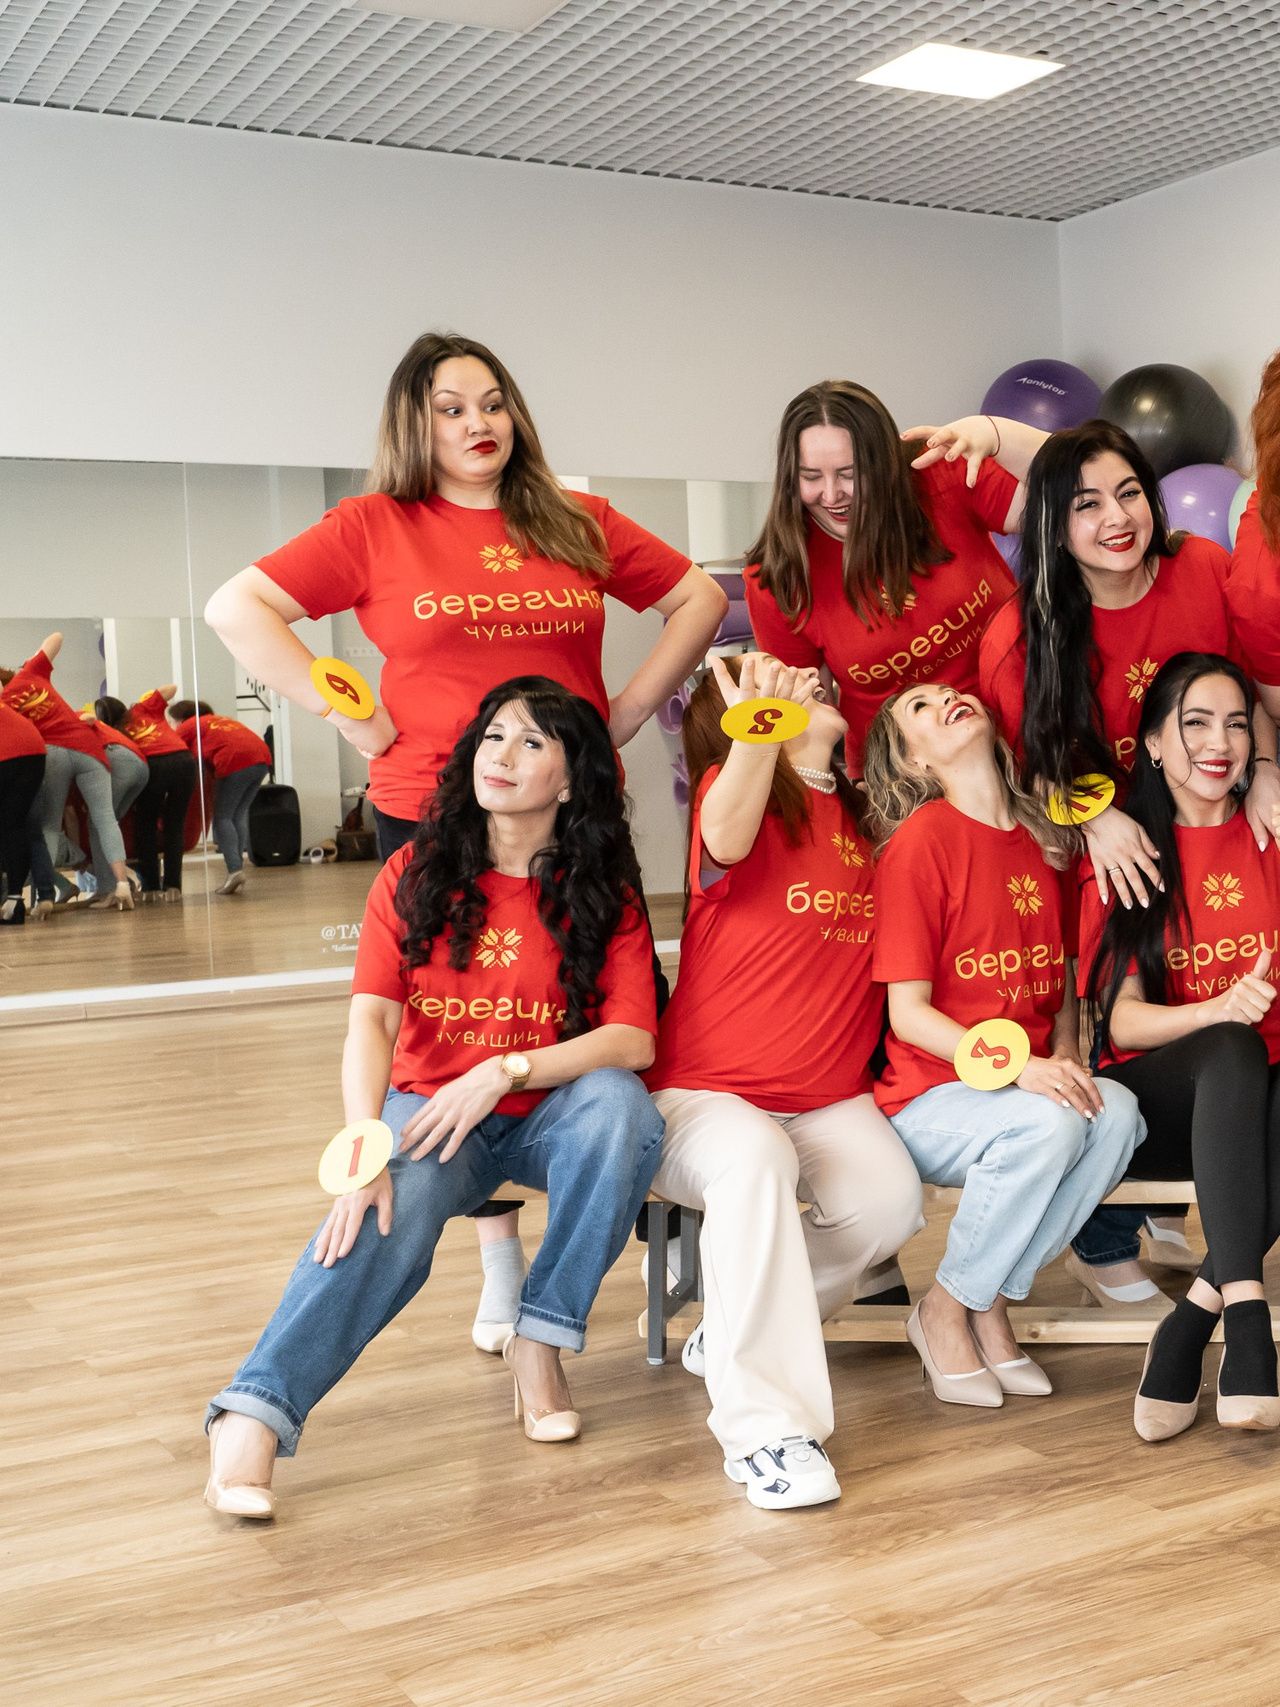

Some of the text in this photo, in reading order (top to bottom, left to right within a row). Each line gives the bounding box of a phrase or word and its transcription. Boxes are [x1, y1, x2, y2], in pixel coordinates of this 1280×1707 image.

[464, 621, 585, 641] чувашии
[848, 578, 993, 685] берегиня
[786, 881, 875, 921] берег
[955, 943, 1065, 981] береги
[347, 1135, 364, 1178] 1
